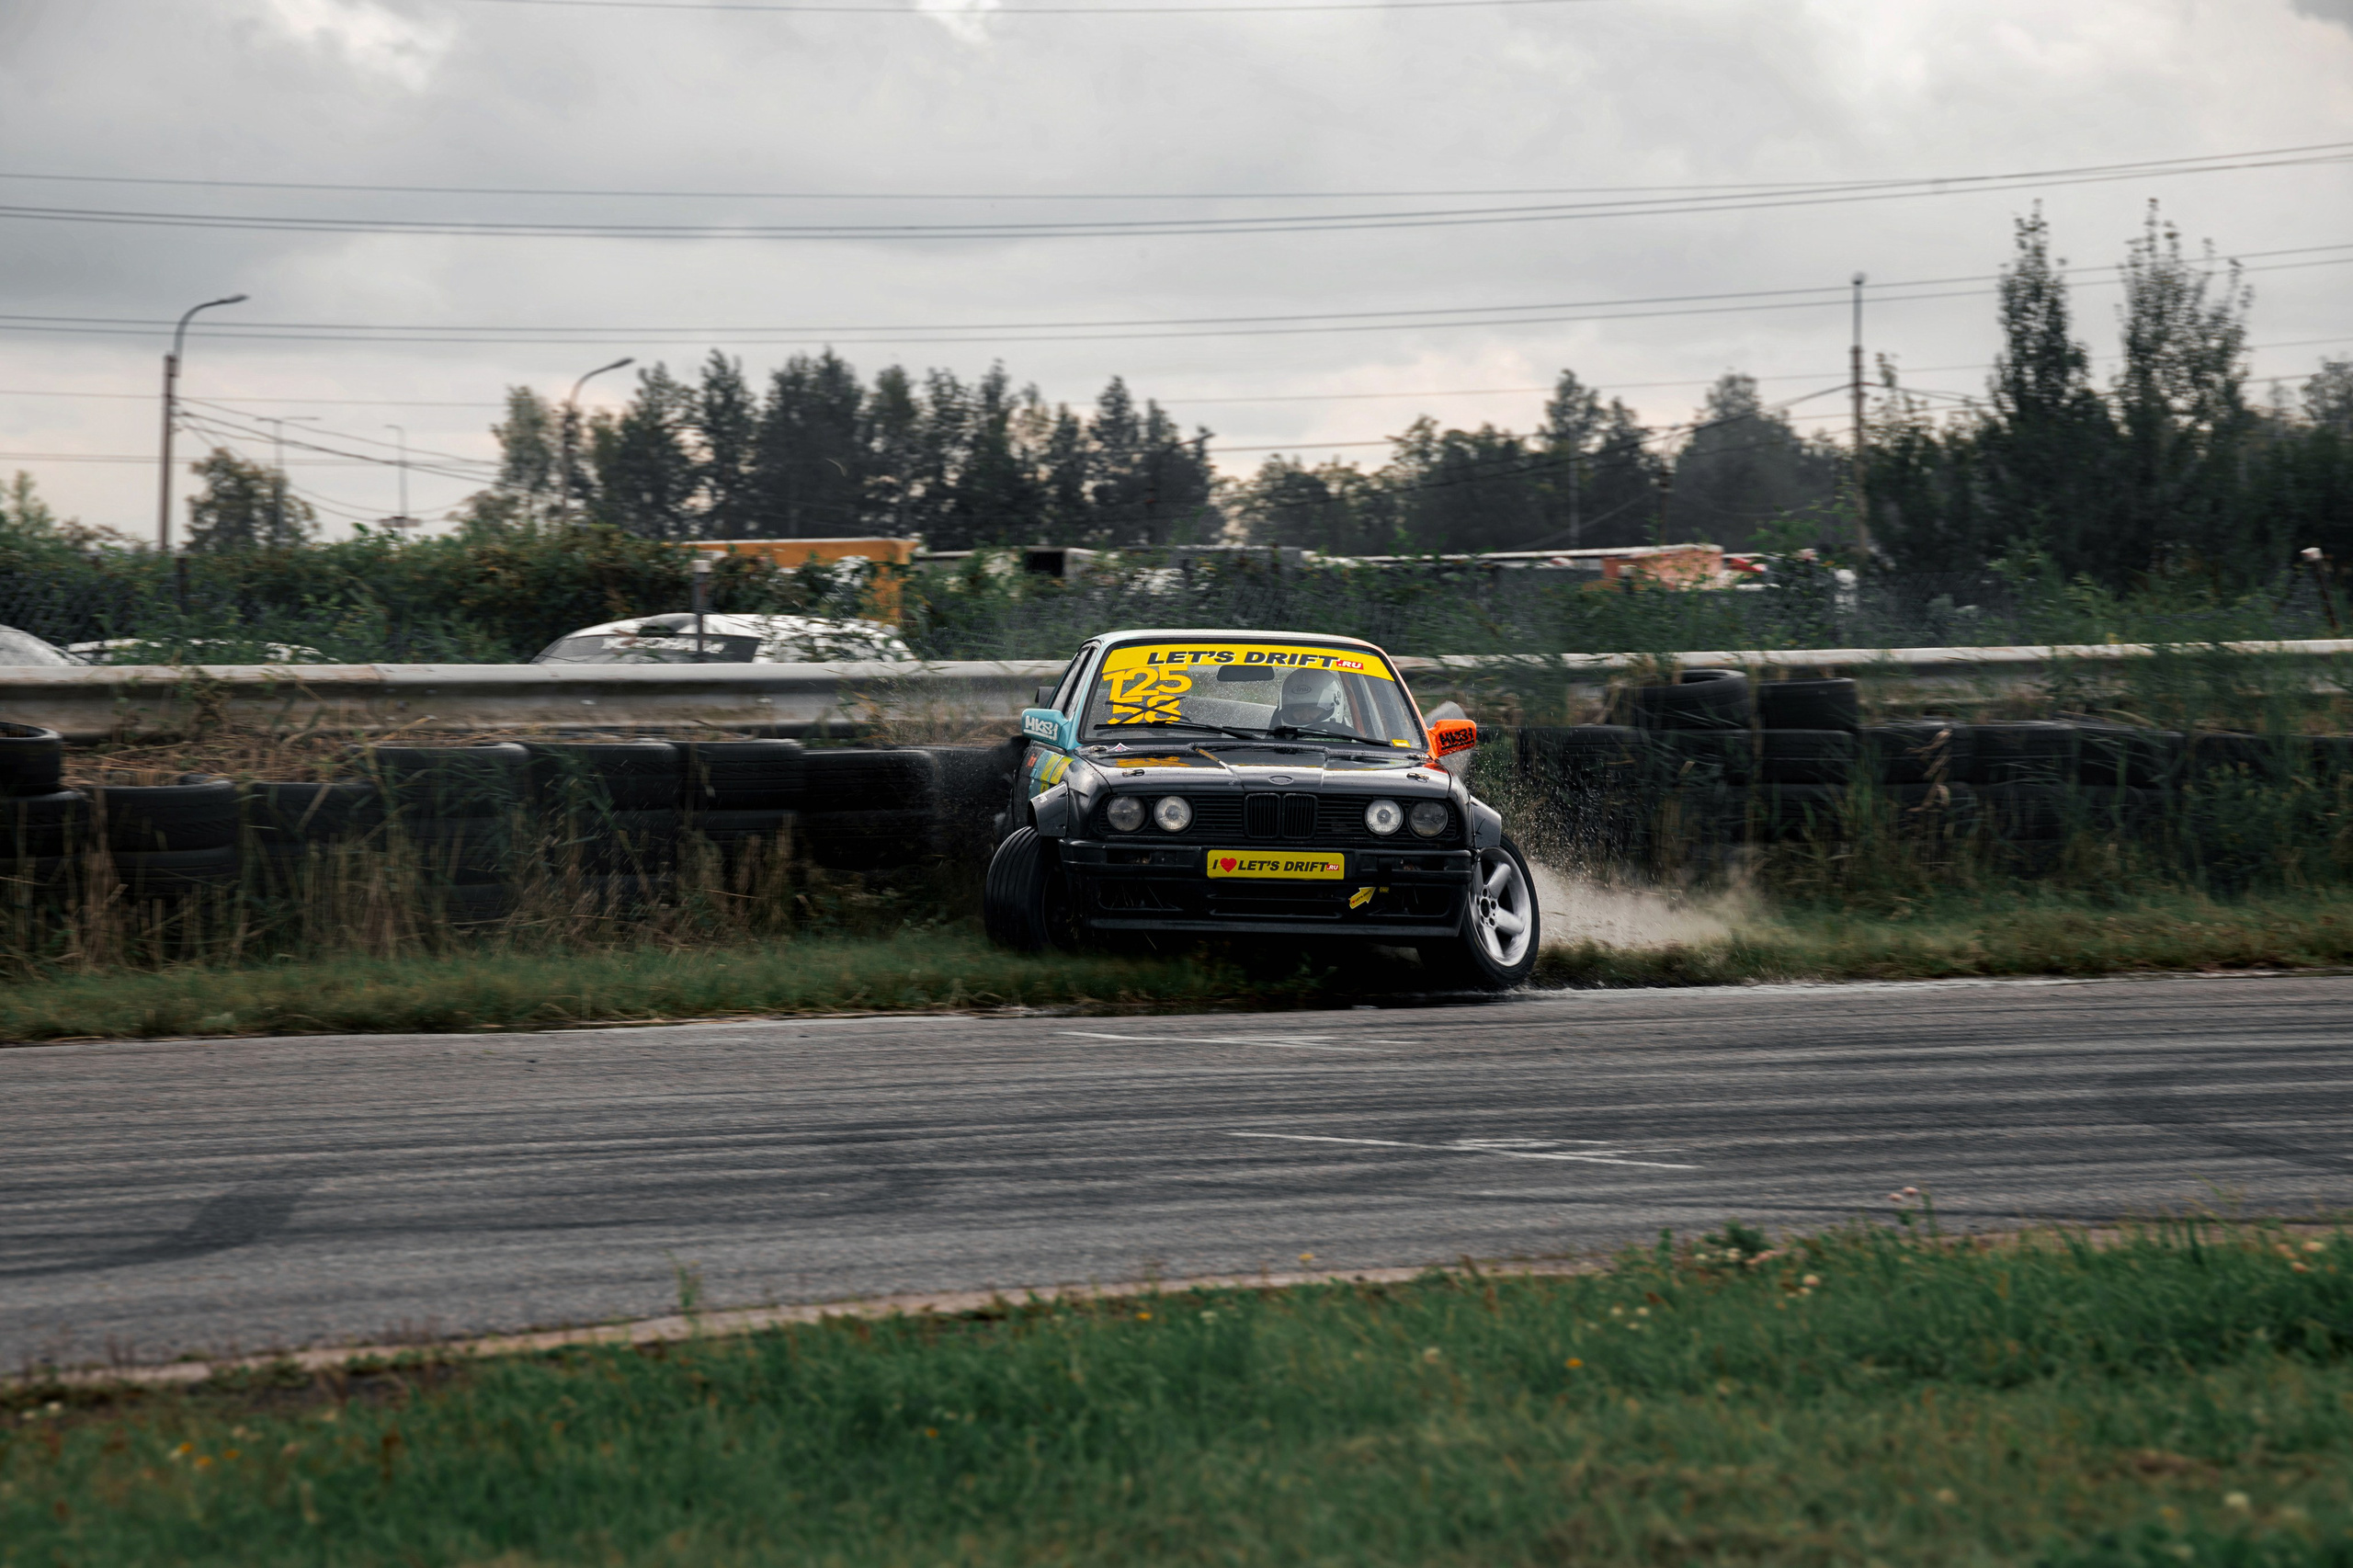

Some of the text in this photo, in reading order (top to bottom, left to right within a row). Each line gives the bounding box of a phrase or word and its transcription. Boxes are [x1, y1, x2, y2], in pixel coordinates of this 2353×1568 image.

[1147, 650, 1235, 665] LET'S
[1102, 665, 1193, 701] 125
[1212, 859, 1219, 869] I
[1237, 859, 1280, 871] LET'S
